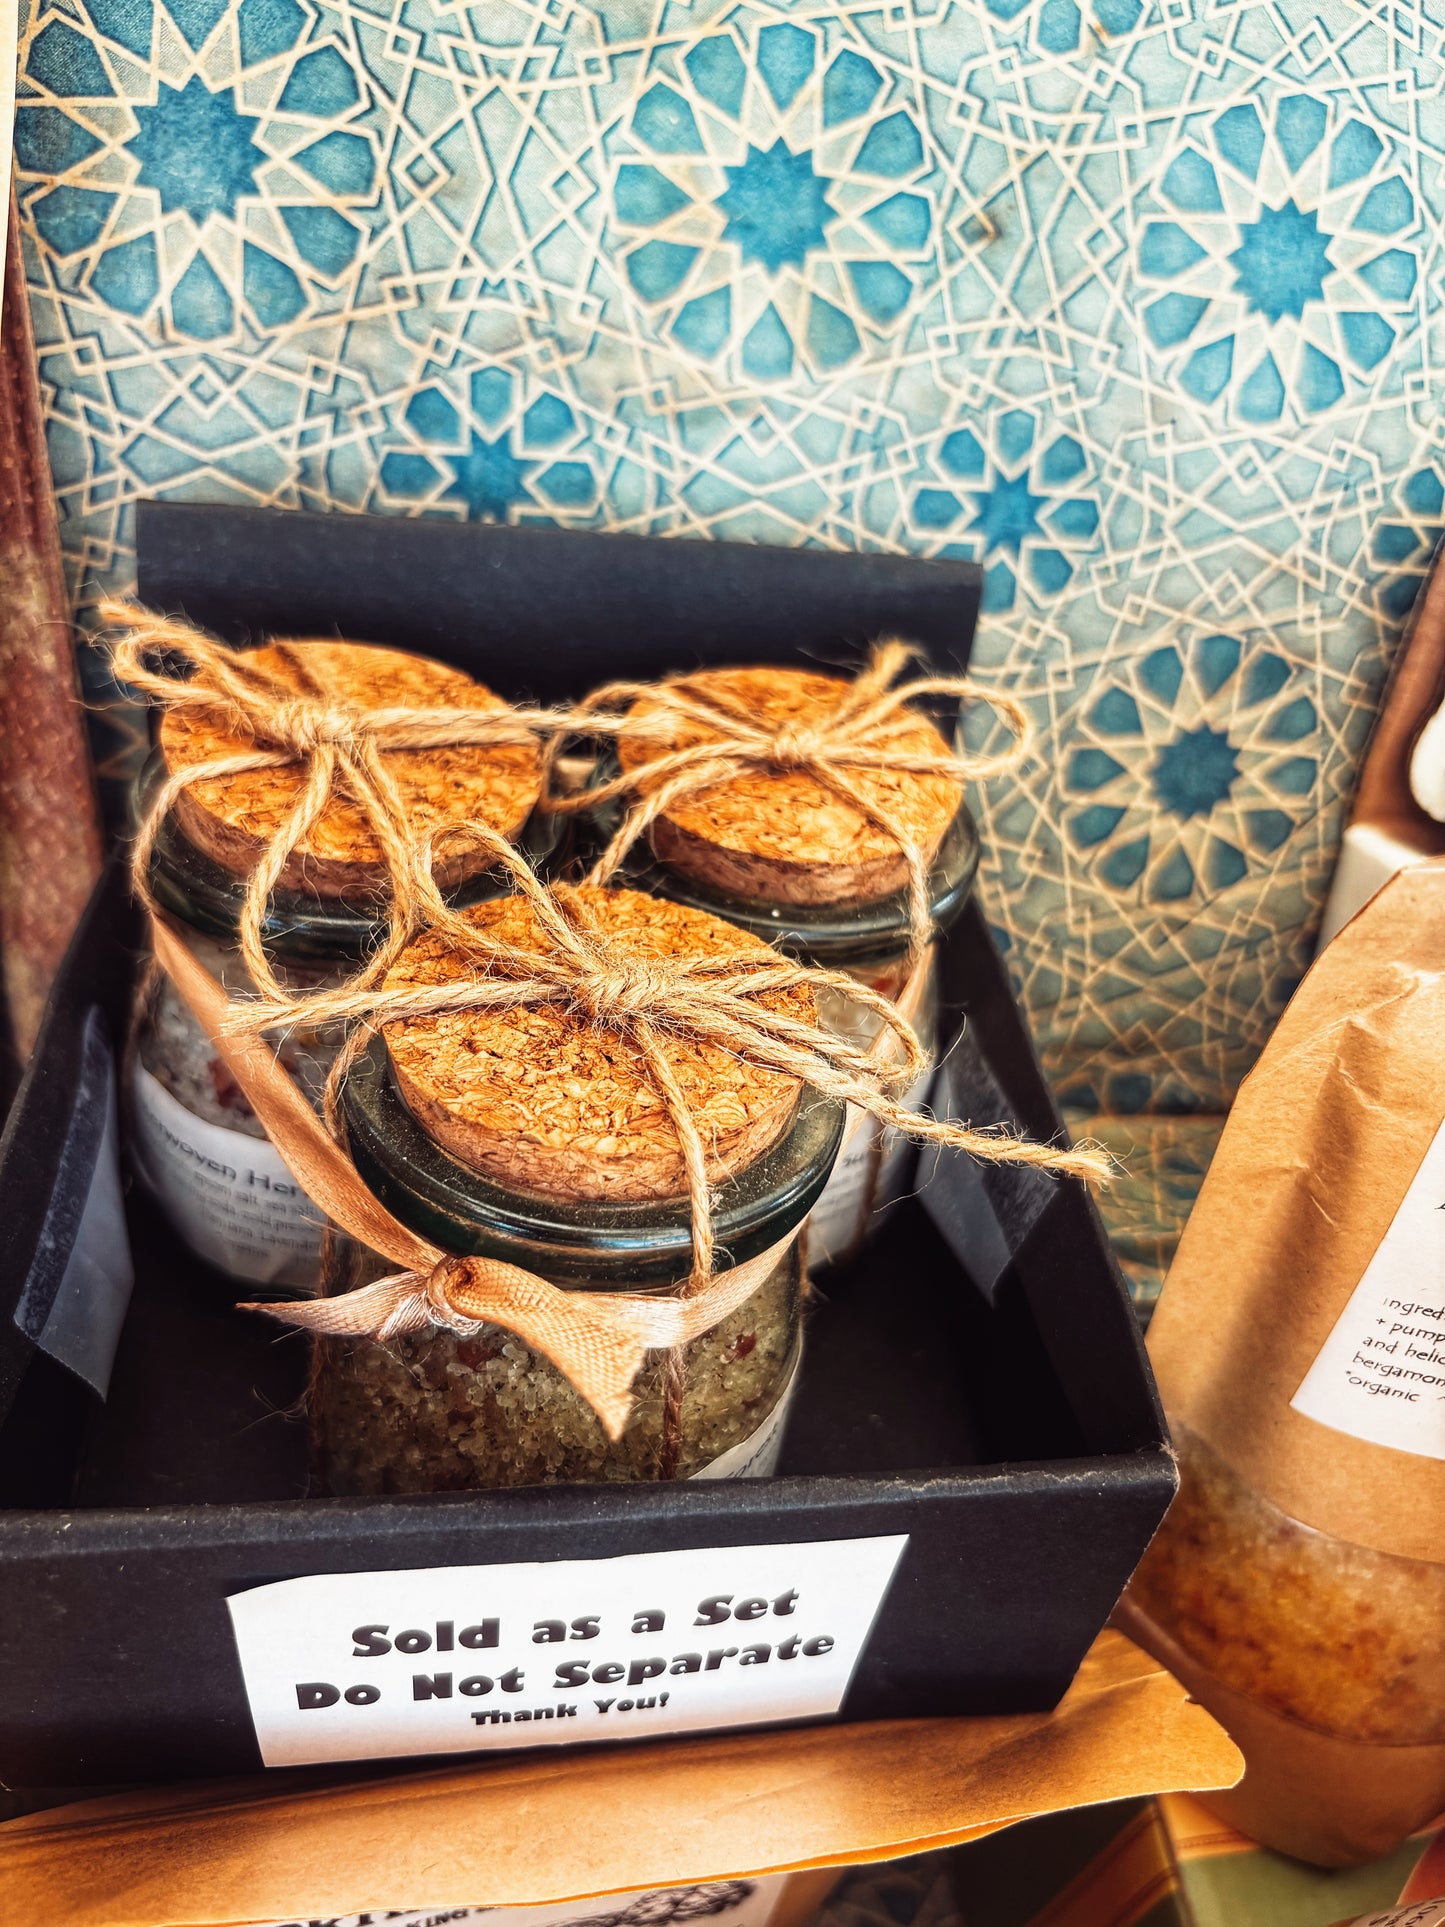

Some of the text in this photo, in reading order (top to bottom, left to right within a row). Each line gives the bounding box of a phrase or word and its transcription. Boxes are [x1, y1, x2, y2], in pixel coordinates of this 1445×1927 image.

[246, 1167, 311, 1199] Her
[1362, 1336, 1399, 1355] and
[351, 1586, 800, 1658] Sold as a Set
[295, 1631, 836, 1710] Do Not Separate
[470, 1691, 671, 1726] Thank You!
